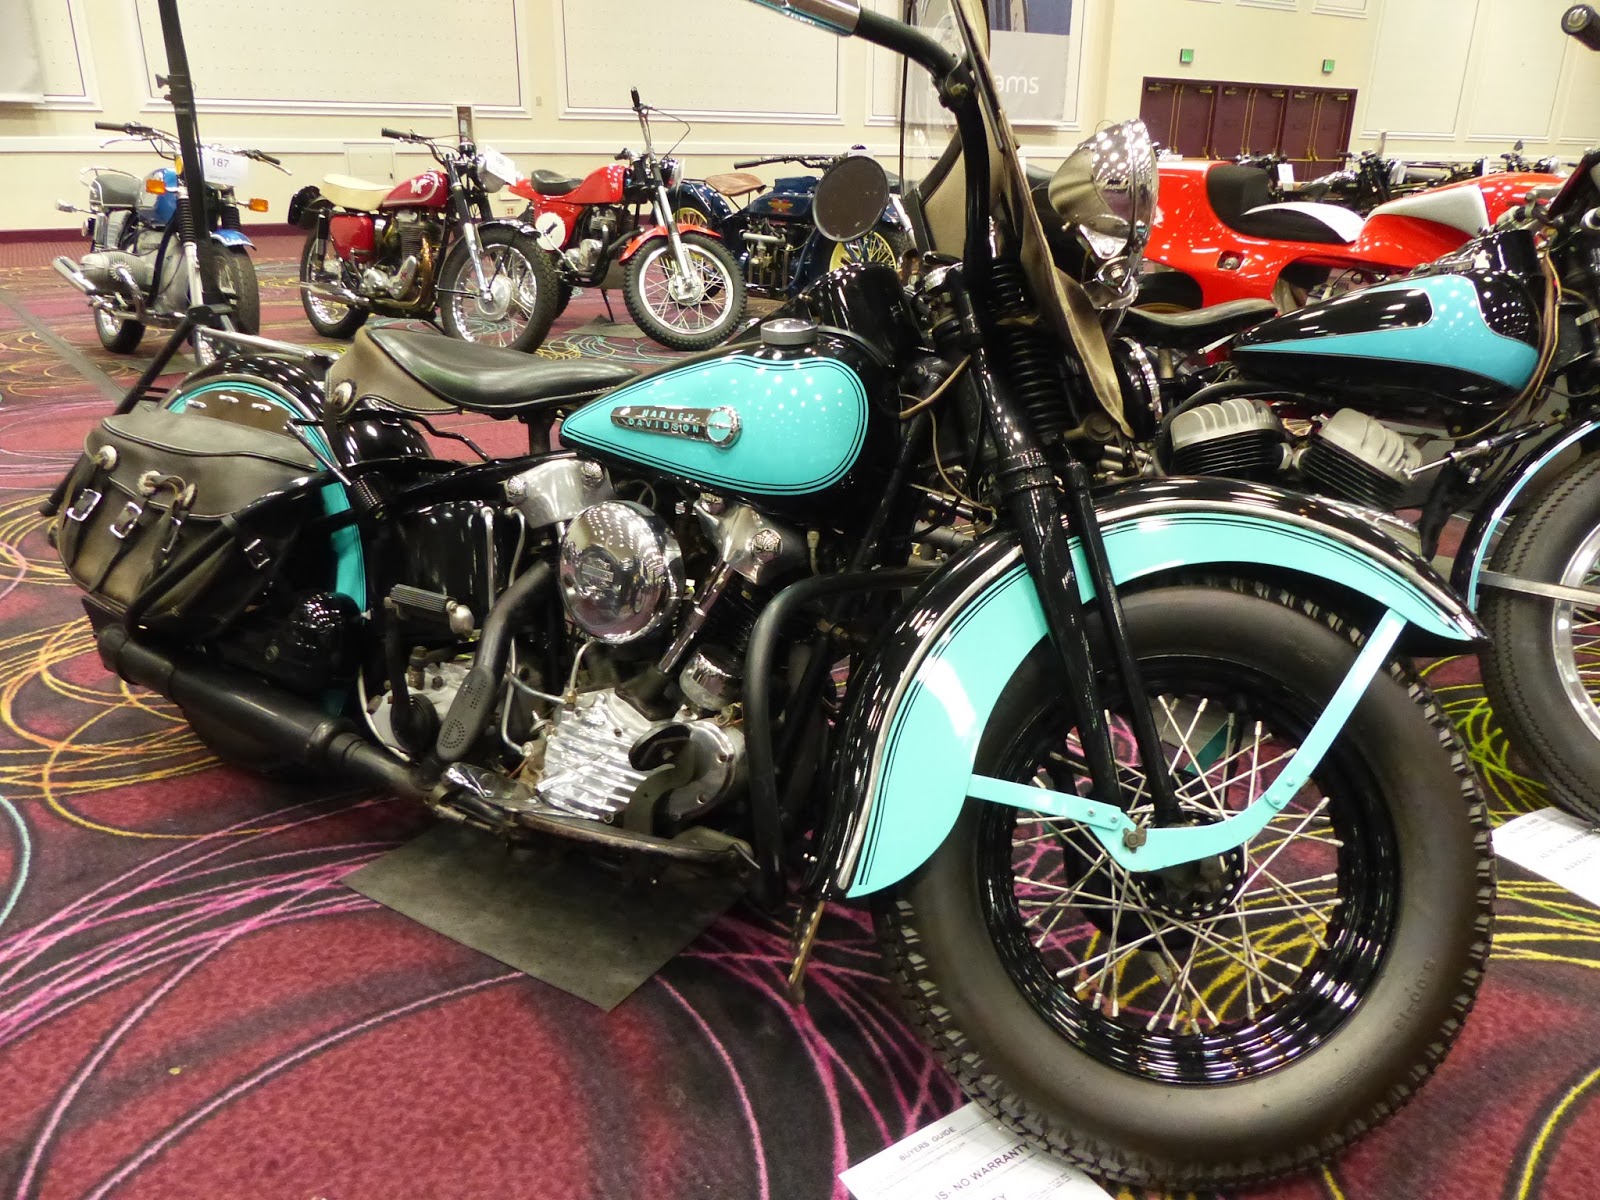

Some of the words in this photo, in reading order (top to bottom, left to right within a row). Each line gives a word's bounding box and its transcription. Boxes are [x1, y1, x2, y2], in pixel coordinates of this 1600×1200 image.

[211, 157, 230, 168] 187
[628, 417, 699, 433] DAVIDSON
[899, 1141, 930, 1161] BUYERS
[931, 1126, 956, 1142] GUIDE
[953, 1178, 970, 1191] NO
[970, 1142, 1030, 1180] WARRANTY
